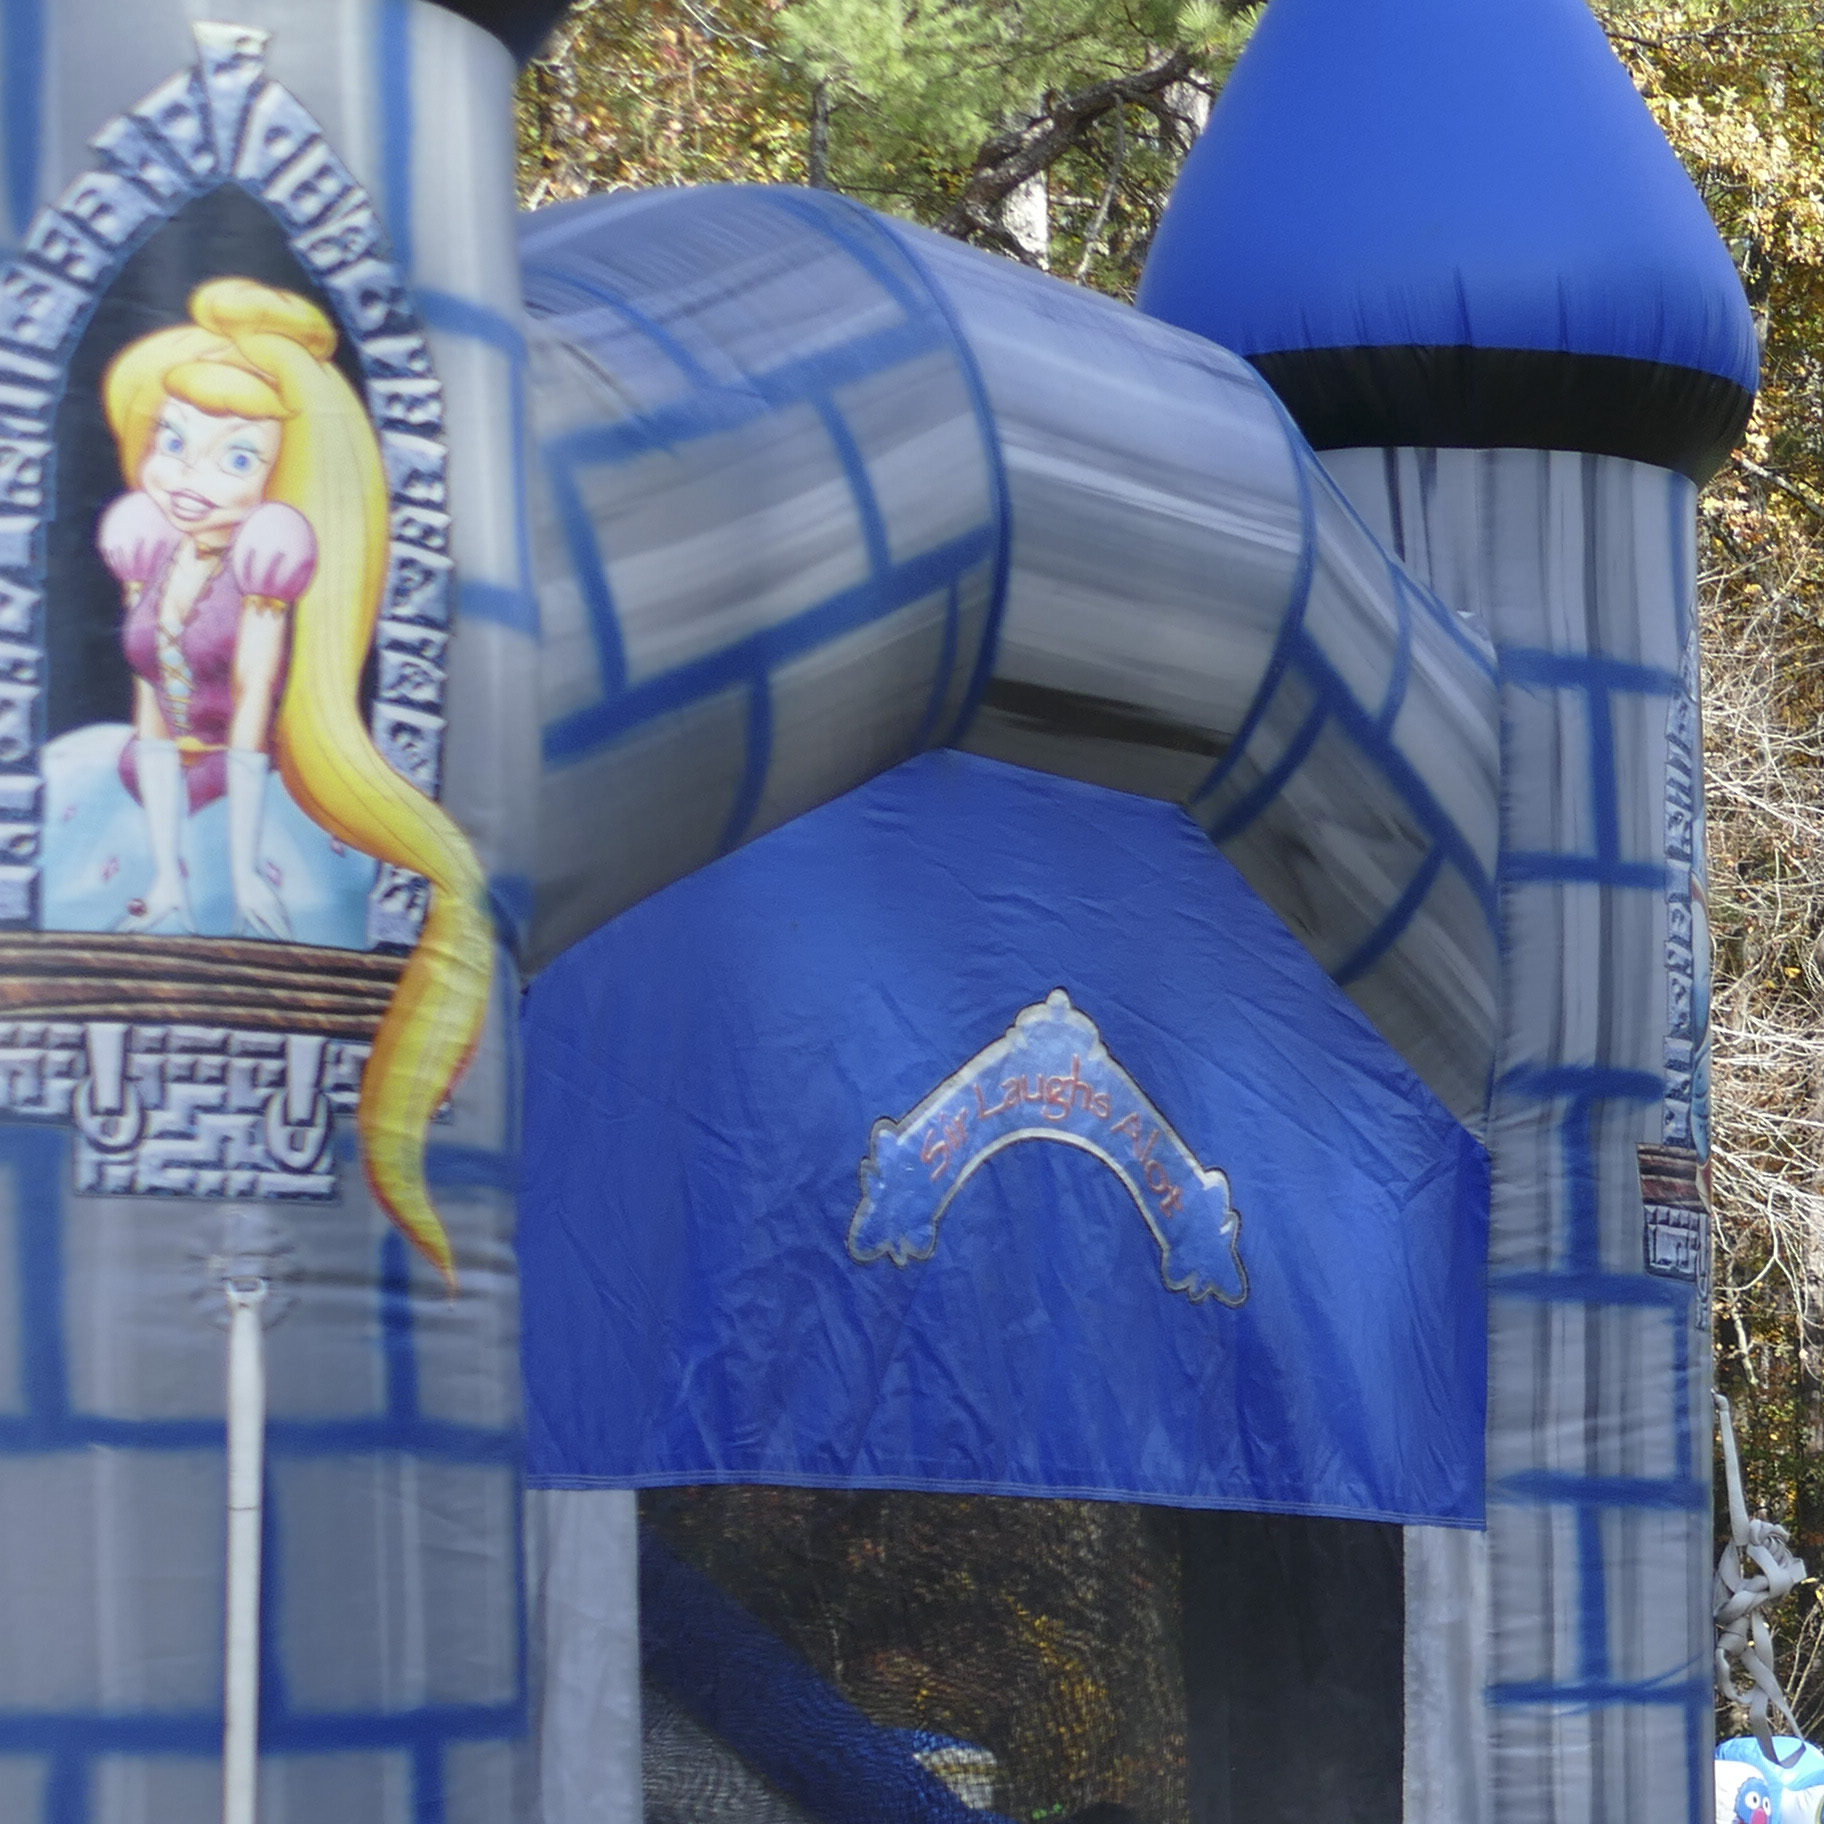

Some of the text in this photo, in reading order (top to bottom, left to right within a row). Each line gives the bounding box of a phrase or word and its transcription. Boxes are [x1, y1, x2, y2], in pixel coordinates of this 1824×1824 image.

[920, 1053, 1185, 1218] Sir Laughs Alot
